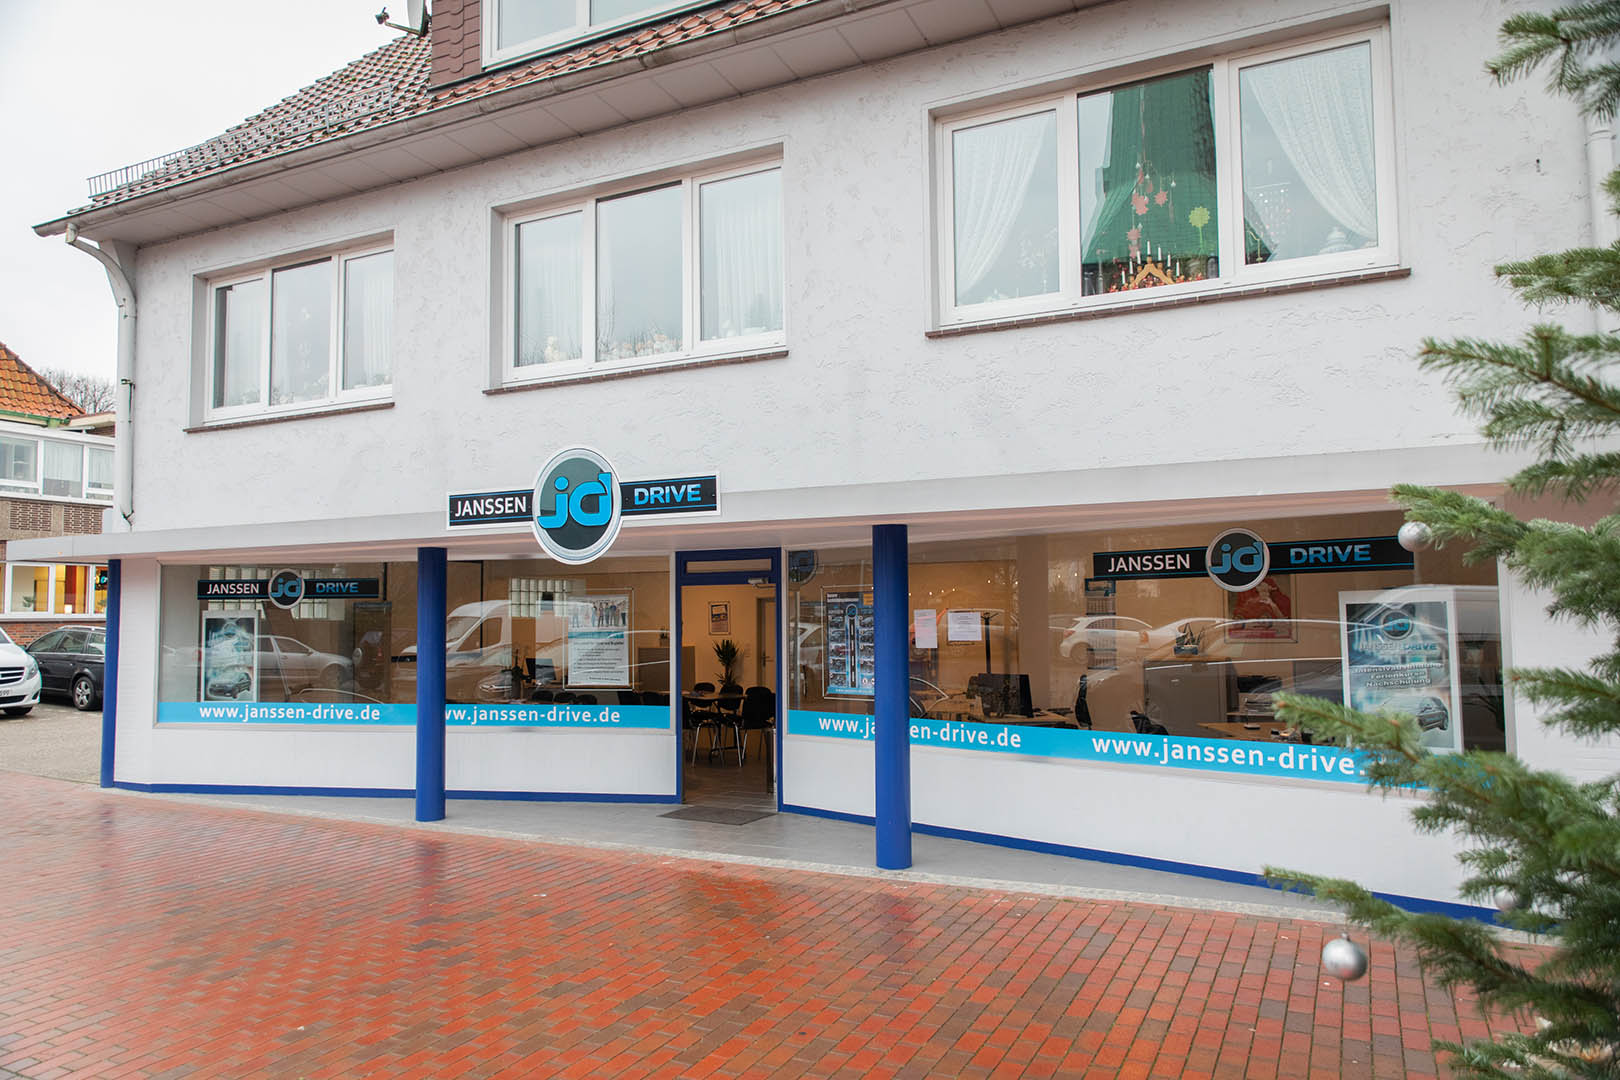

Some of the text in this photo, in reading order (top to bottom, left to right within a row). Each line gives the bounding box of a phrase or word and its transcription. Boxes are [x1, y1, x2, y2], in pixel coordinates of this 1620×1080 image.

[455, 496, 527, 517] JANSSEN
[634, 484, 702, 505] DRIVE
[1108, 554, 1191, 573] JANSSEN
[1289, 544, 1372, 564] DRIVE
[207, 583, 260, 594] JANSSEN
[315, 582, 360, 593] DRIVE
[199, 704, 381, 723] www.janssen-drive.de
[445, 705, 620, 725] w.janssen-drive.de
[818, 717, 1022, 748] www.jaen-drive.de
[1092, 738, 1367, 776] www.janssen-drive.
